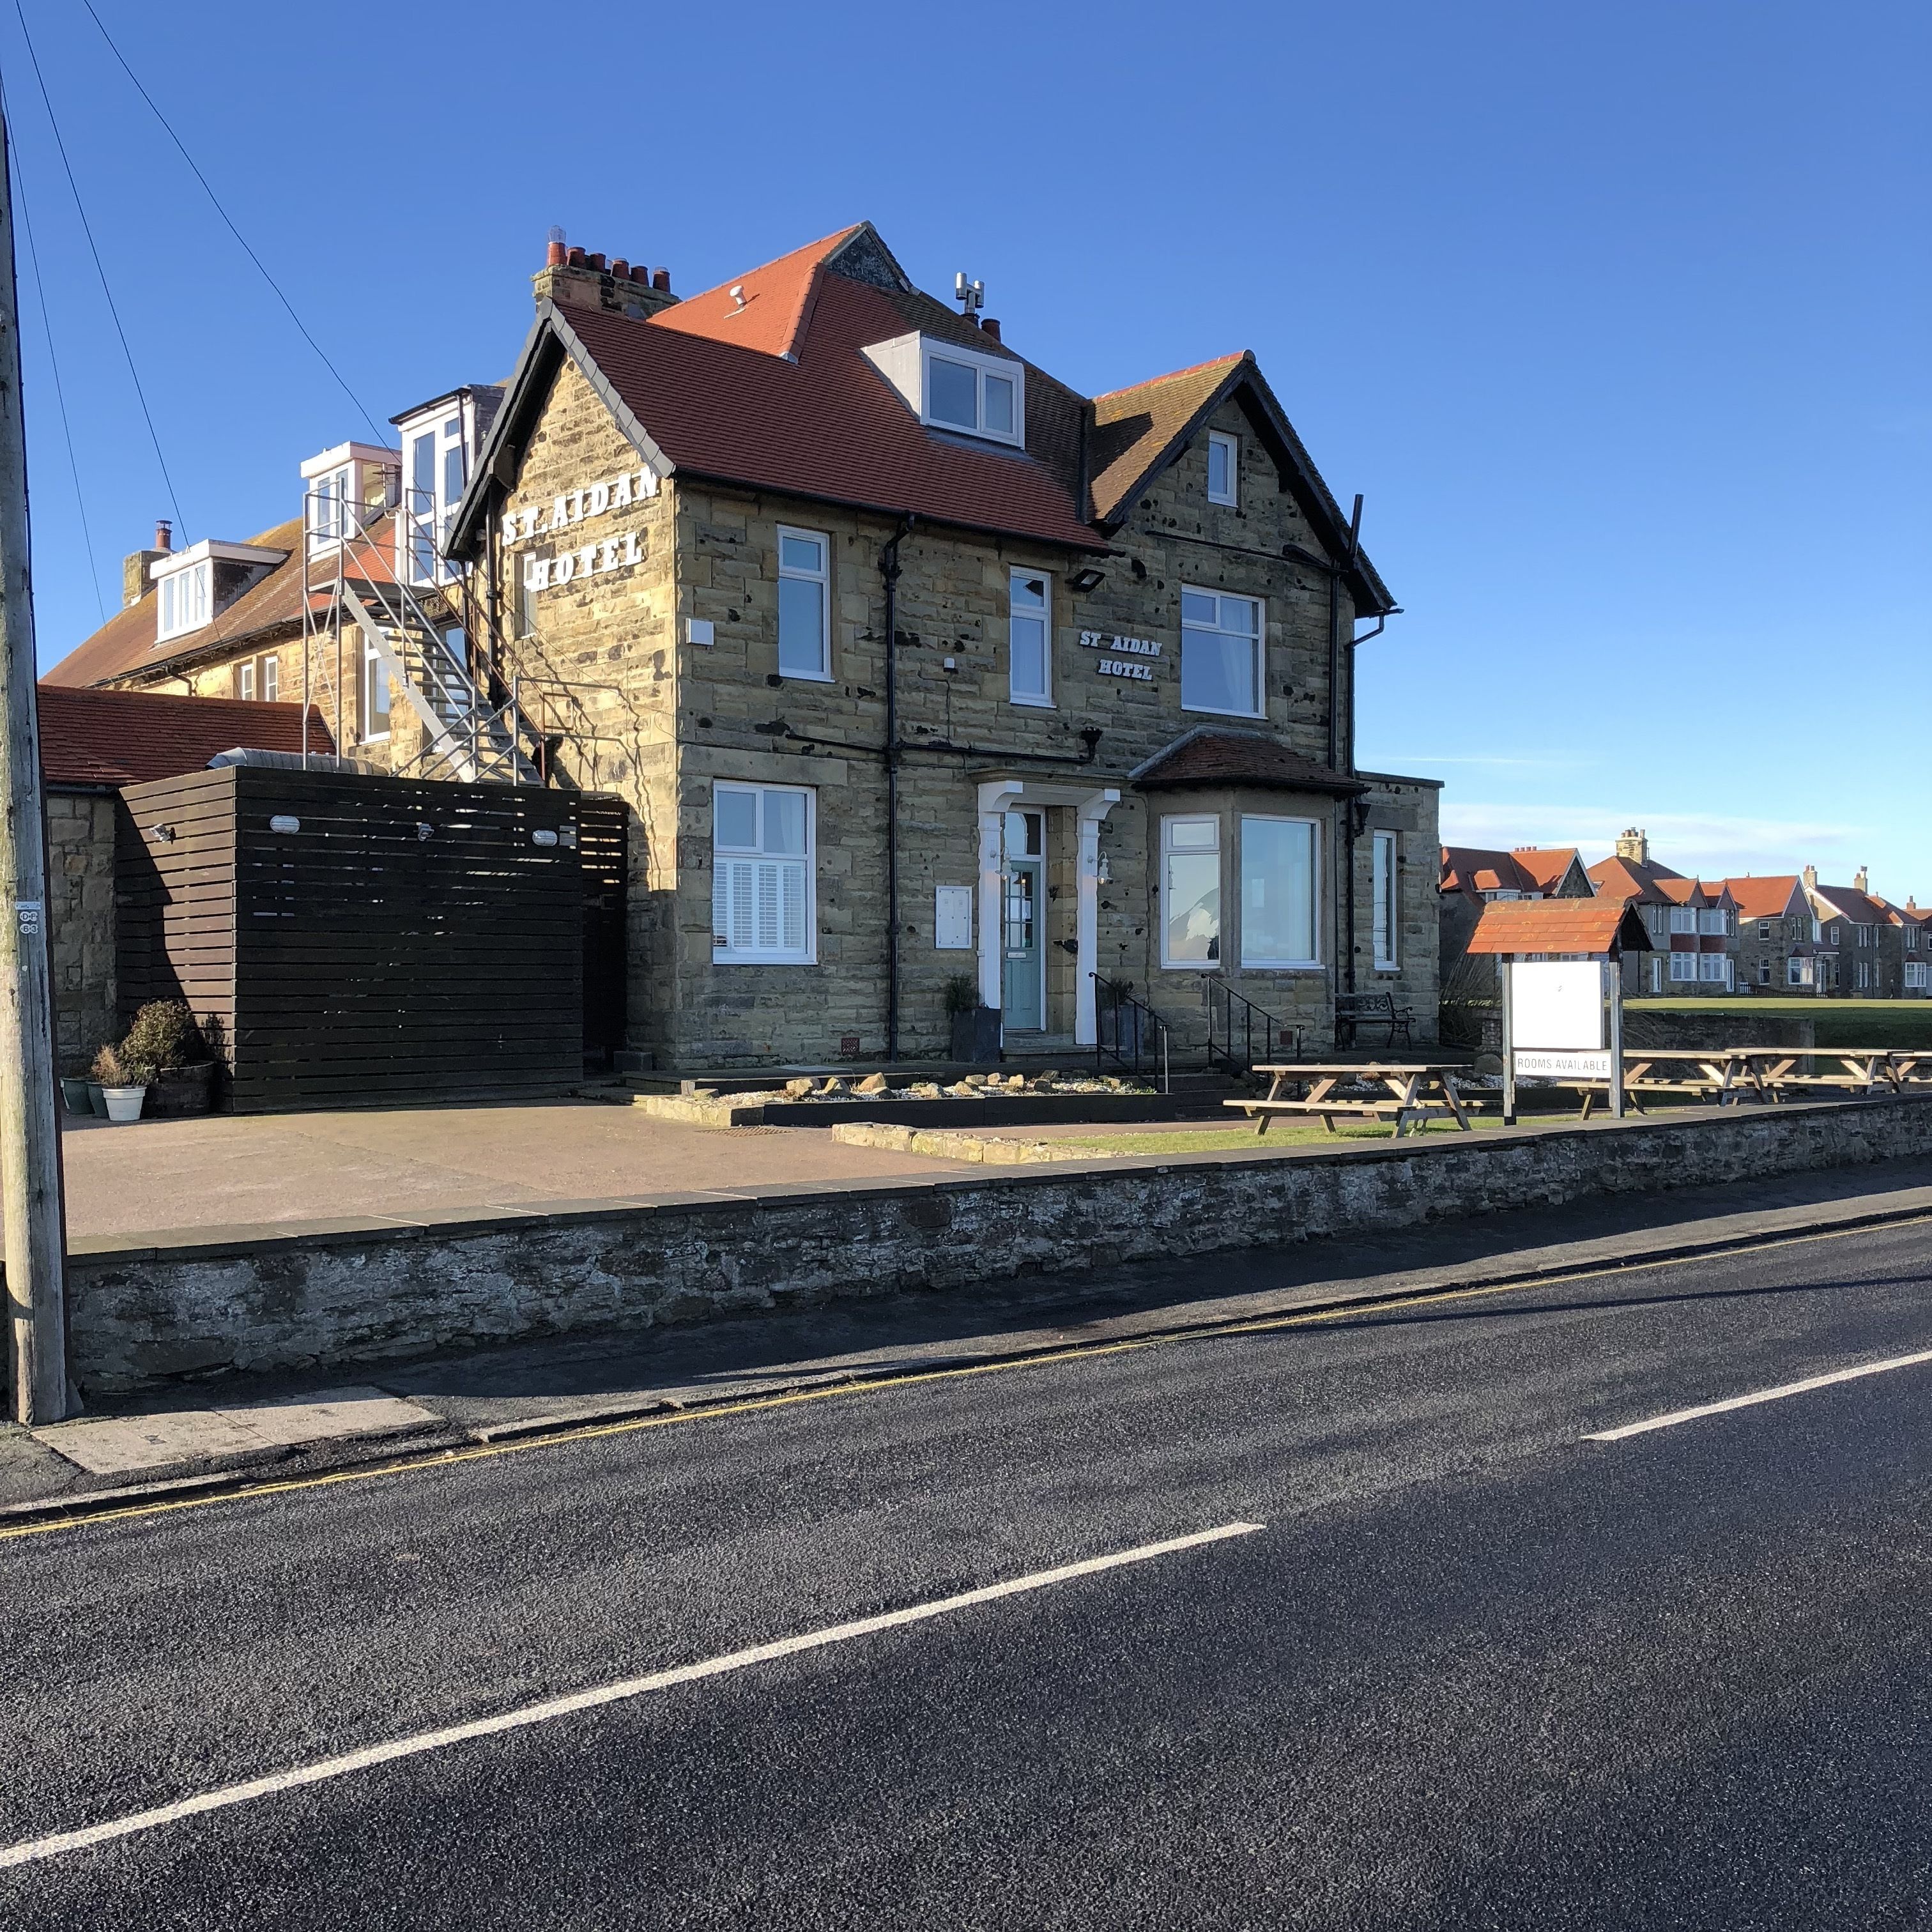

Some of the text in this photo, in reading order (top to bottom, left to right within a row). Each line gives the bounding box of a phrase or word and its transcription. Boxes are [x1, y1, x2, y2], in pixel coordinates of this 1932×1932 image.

[551, 466, 657, 529] AIDAN
[530, 531, 642, 593] HOTEL
[1080, 631, 1162, 656] ST AIDAN
[1098, 659, 1152, 680] HOTEL
[1517, 1058, 1607, 1071] ROOMS AVAILABLE
